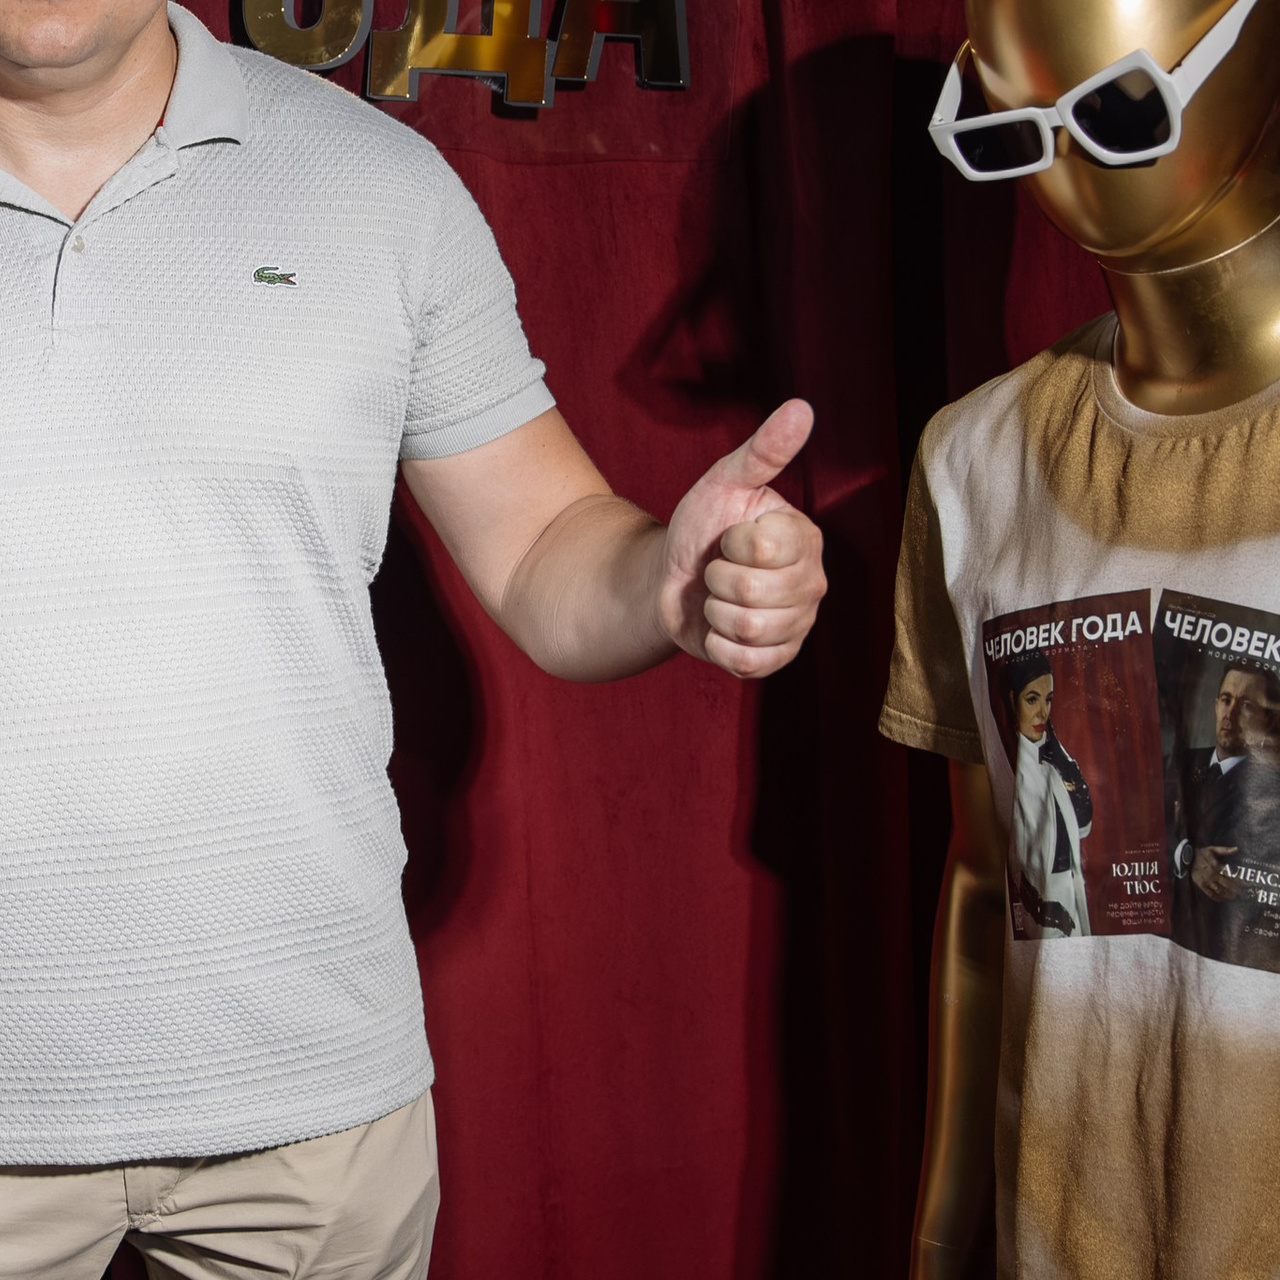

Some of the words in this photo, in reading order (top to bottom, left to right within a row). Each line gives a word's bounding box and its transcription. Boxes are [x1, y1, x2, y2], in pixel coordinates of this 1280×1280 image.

[985, 620, 1065, 661] ЧЕЛОВЕК
[1071, 610, 1143, 642] ГОДА
[1208, 650, 1247, 665] НОВОГО
[1254, 661, 1280, 675] ФОР
[1112, 861, 1159, 877] ЮЛИЯ
[1220, 863, 1280, 888] АЛЕКС
[1123, 880, 1161, 895] ТЮС
[1257, 889, 1280, 906] ВЕ
